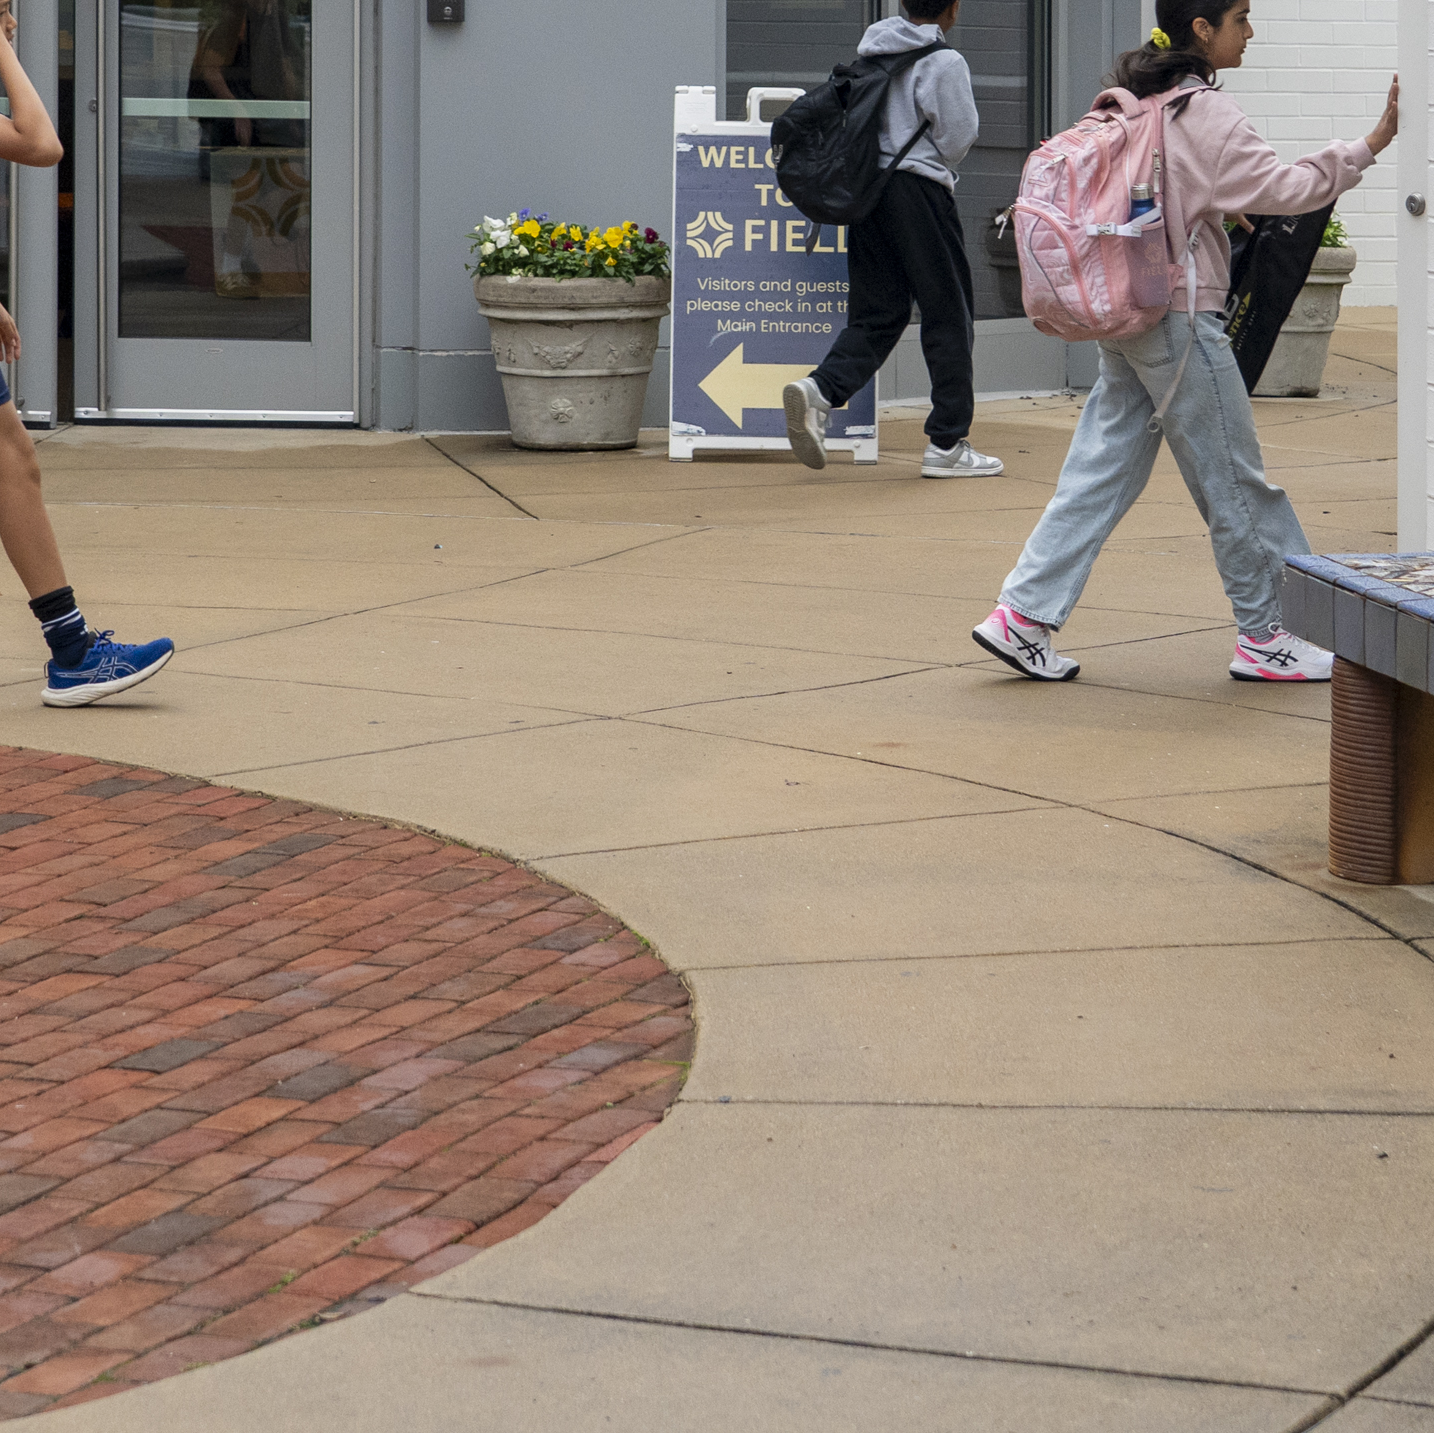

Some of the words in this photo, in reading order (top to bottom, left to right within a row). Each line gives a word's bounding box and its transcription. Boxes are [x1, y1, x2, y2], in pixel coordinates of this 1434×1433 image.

[698, 145, 776, 169] WELC
[697, 277, 755, 291] Visitors
[759, 278, 791, 292] and
[795, 280, 850, 296] guests
[686, 298, 741, 314] please
[745, 299, 793, 312] check
[797, 299, 811, 312] in
[816, 301, 832, 313] at
[717, 319, 756, 332] Main
[761, 319, 832, 333] Entrance
